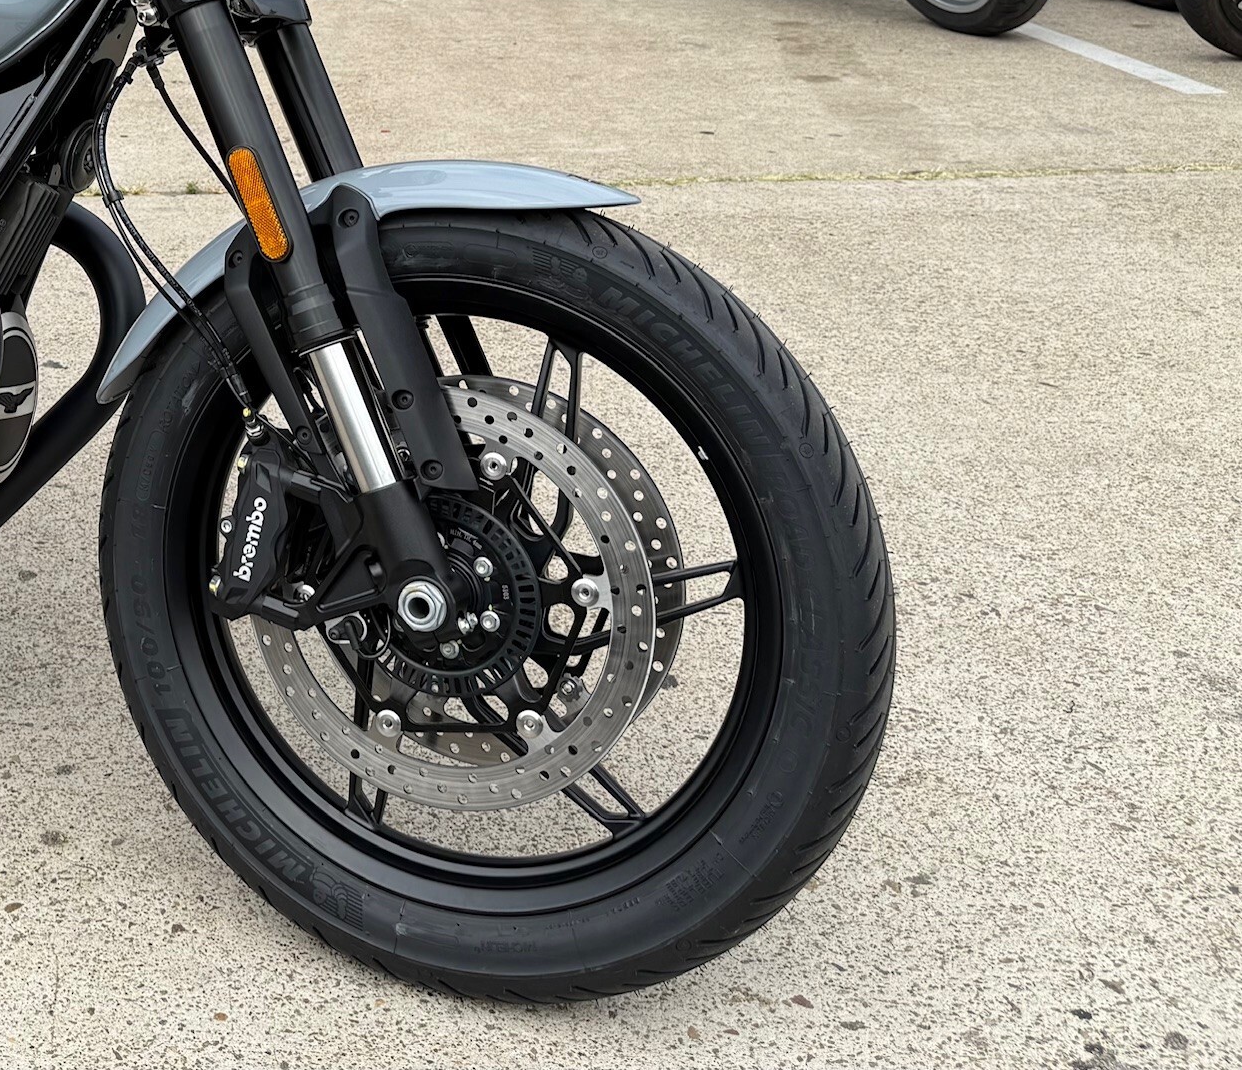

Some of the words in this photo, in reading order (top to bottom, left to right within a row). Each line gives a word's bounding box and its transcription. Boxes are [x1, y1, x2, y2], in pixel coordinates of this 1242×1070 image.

[597, 284, 773, 456] MICHELIN
[232, 496, 268, 582] brembo
[164, 717, 315, 884] MICHELIN
